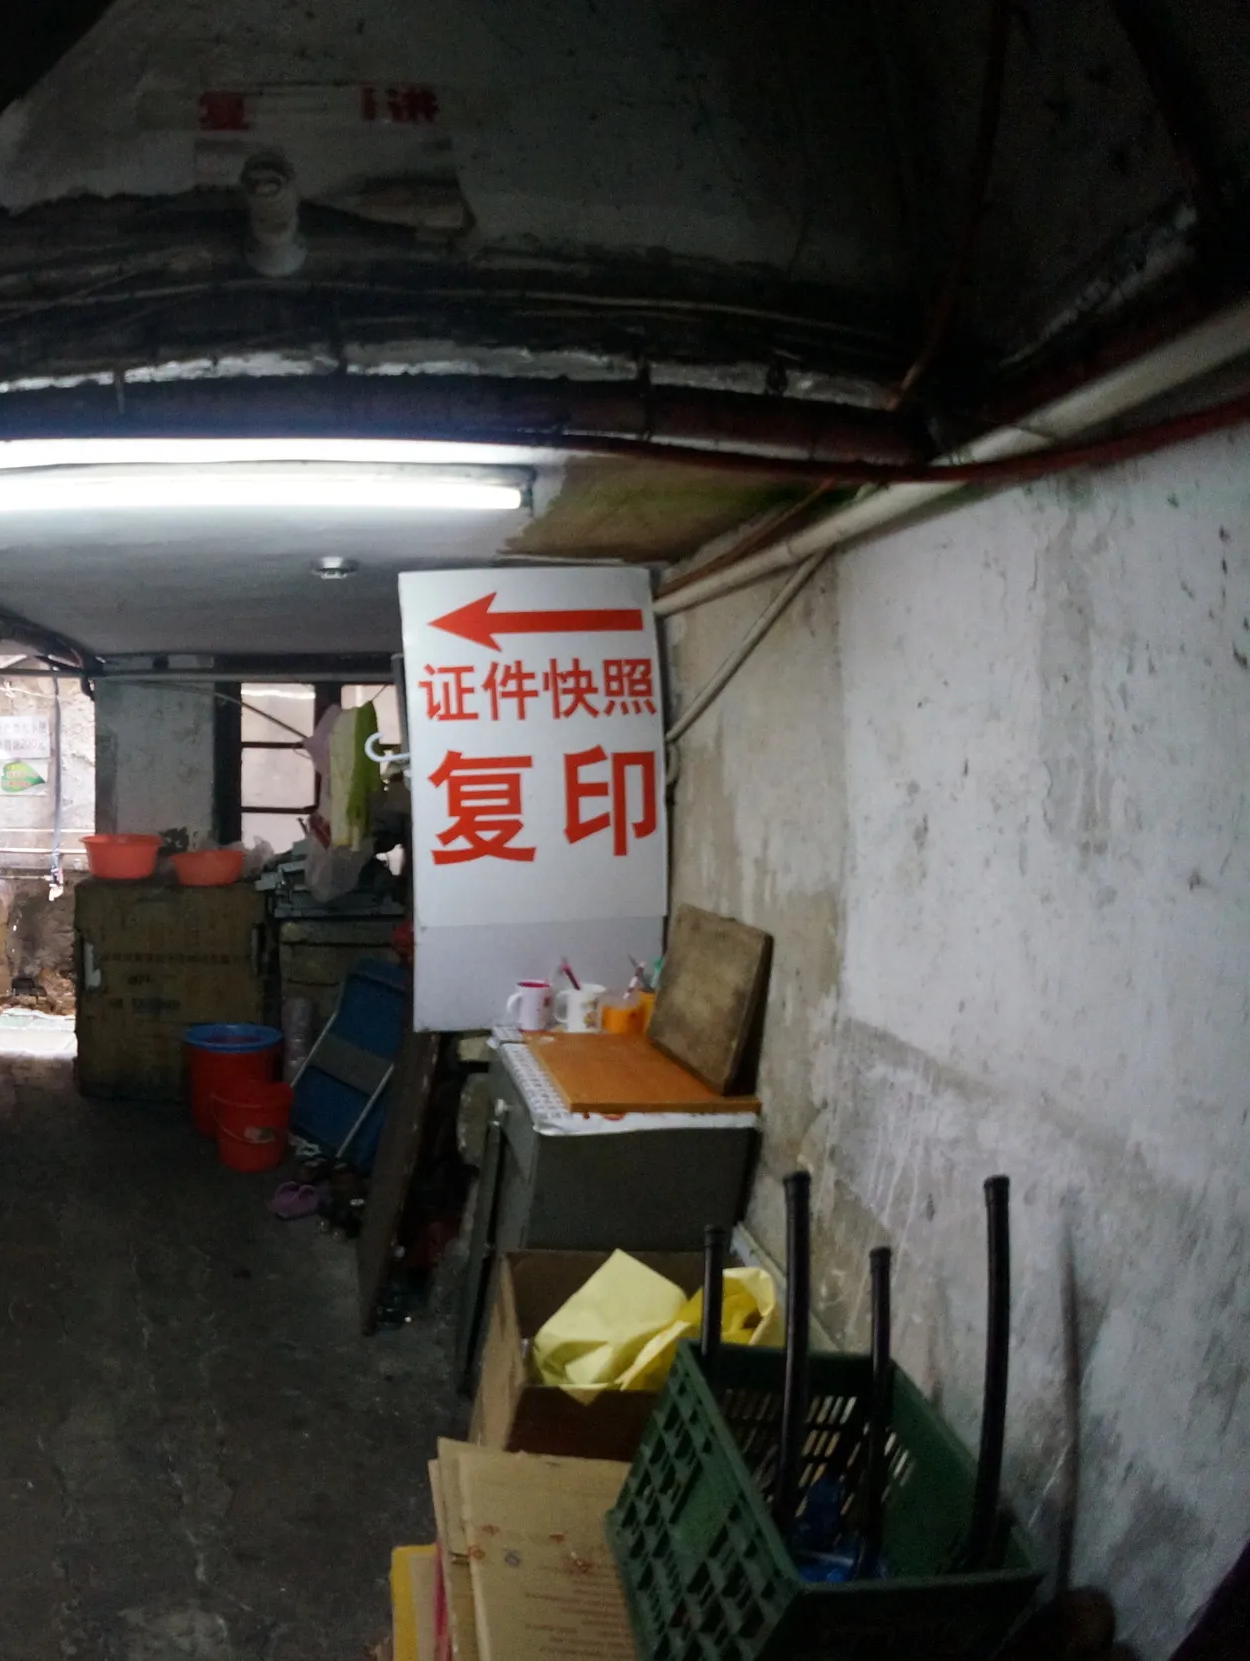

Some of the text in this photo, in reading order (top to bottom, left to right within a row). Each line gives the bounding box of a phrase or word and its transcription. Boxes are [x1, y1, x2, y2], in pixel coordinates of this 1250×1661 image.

[418, 657, 658, 722] 证件快照
[427, 743, 658, 866] 复印
